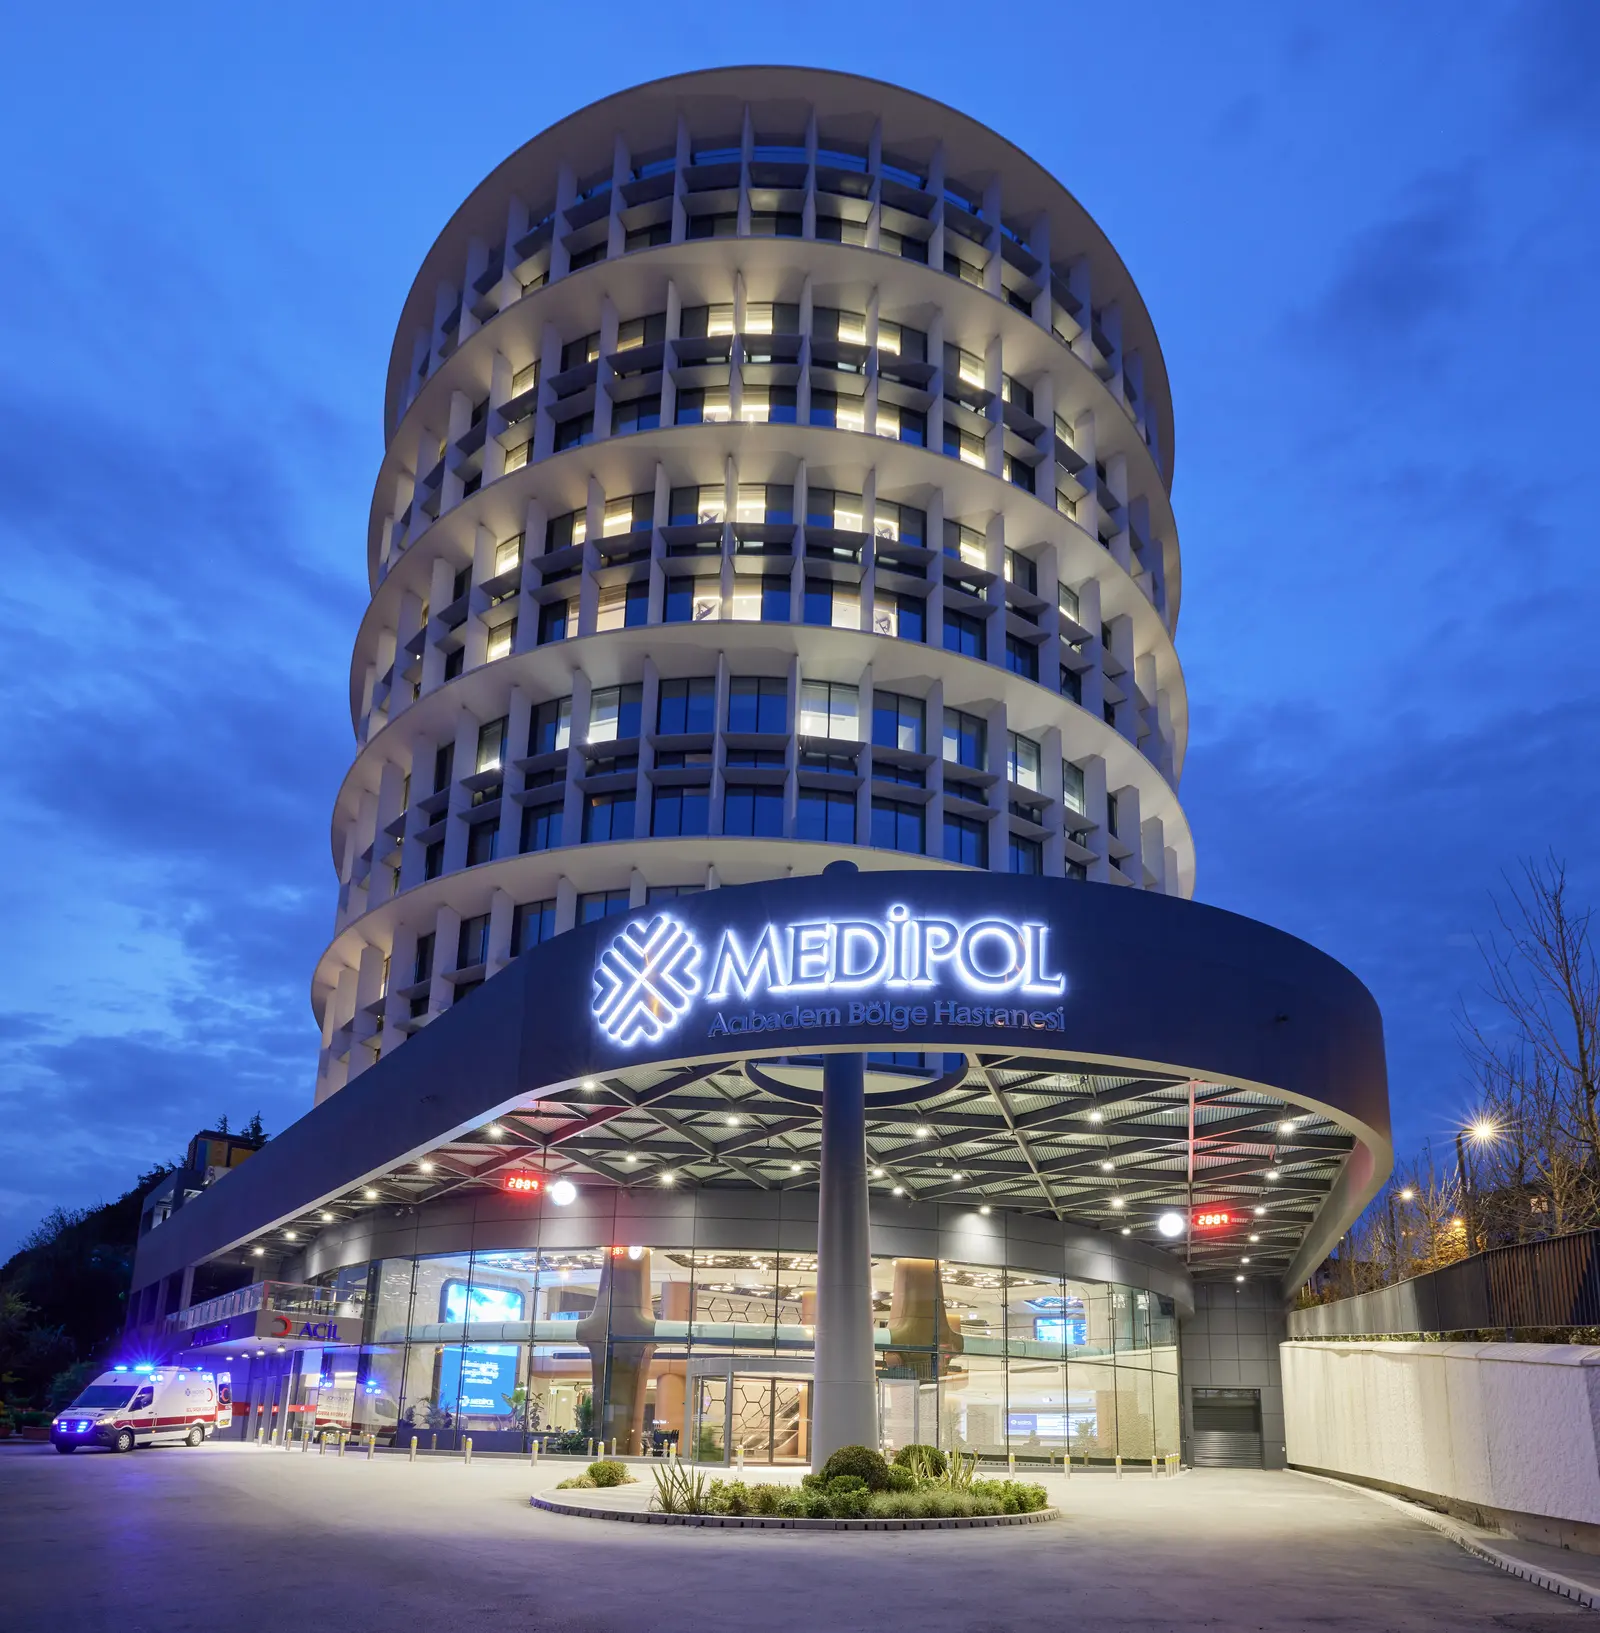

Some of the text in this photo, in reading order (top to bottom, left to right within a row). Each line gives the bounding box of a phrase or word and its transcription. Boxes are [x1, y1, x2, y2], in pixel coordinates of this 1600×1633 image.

[706, 904, 1064, 1000] MEDİPOL
[707, 1000, 1066, 1038] Acıbadem Bölge Hastanesi
[299, 1319, 342, 1341] ACİL
